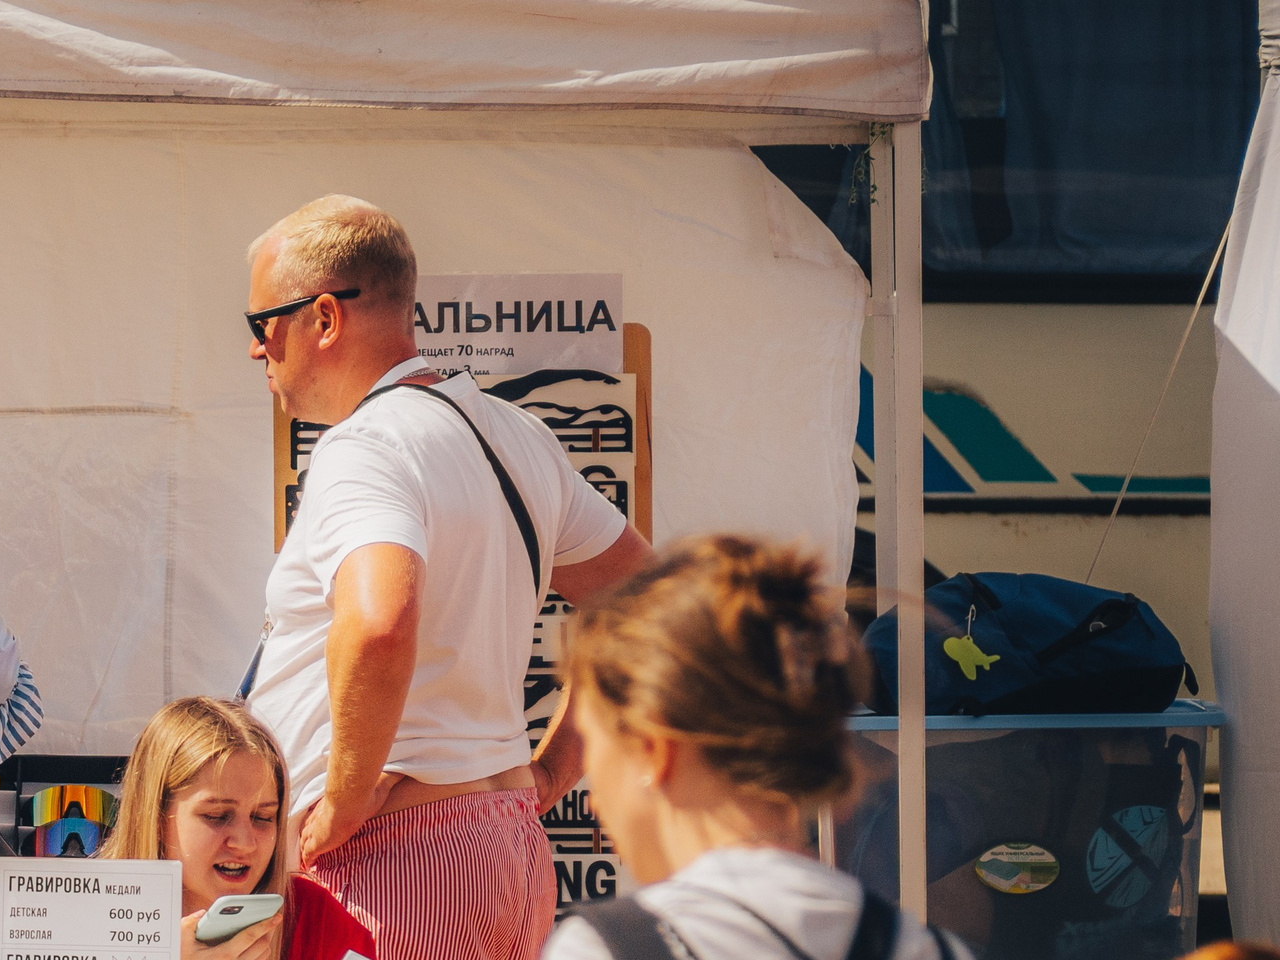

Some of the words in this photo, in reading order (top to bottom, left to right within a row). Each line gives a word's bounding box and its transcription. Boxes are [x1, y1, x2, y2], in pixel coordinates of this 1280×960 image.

[456, 344, 473, 356] 70
[476, 347, 514, 357] НАГРАД
[8, 875, 101, 894] ГРАВИРОВКА
[105, 884, 141, 896] МЕДАЛИ
[9, 906, 47, 918] ДЕТСКАЯ
[109, 908, 133, 920] 600
[137, 908, 161, 923] руб
[9, 929, 52, 940] ВЗРОСЛАЯ
[109, 930, 133, 942] 700
[137, 930, 161, 944] руб
